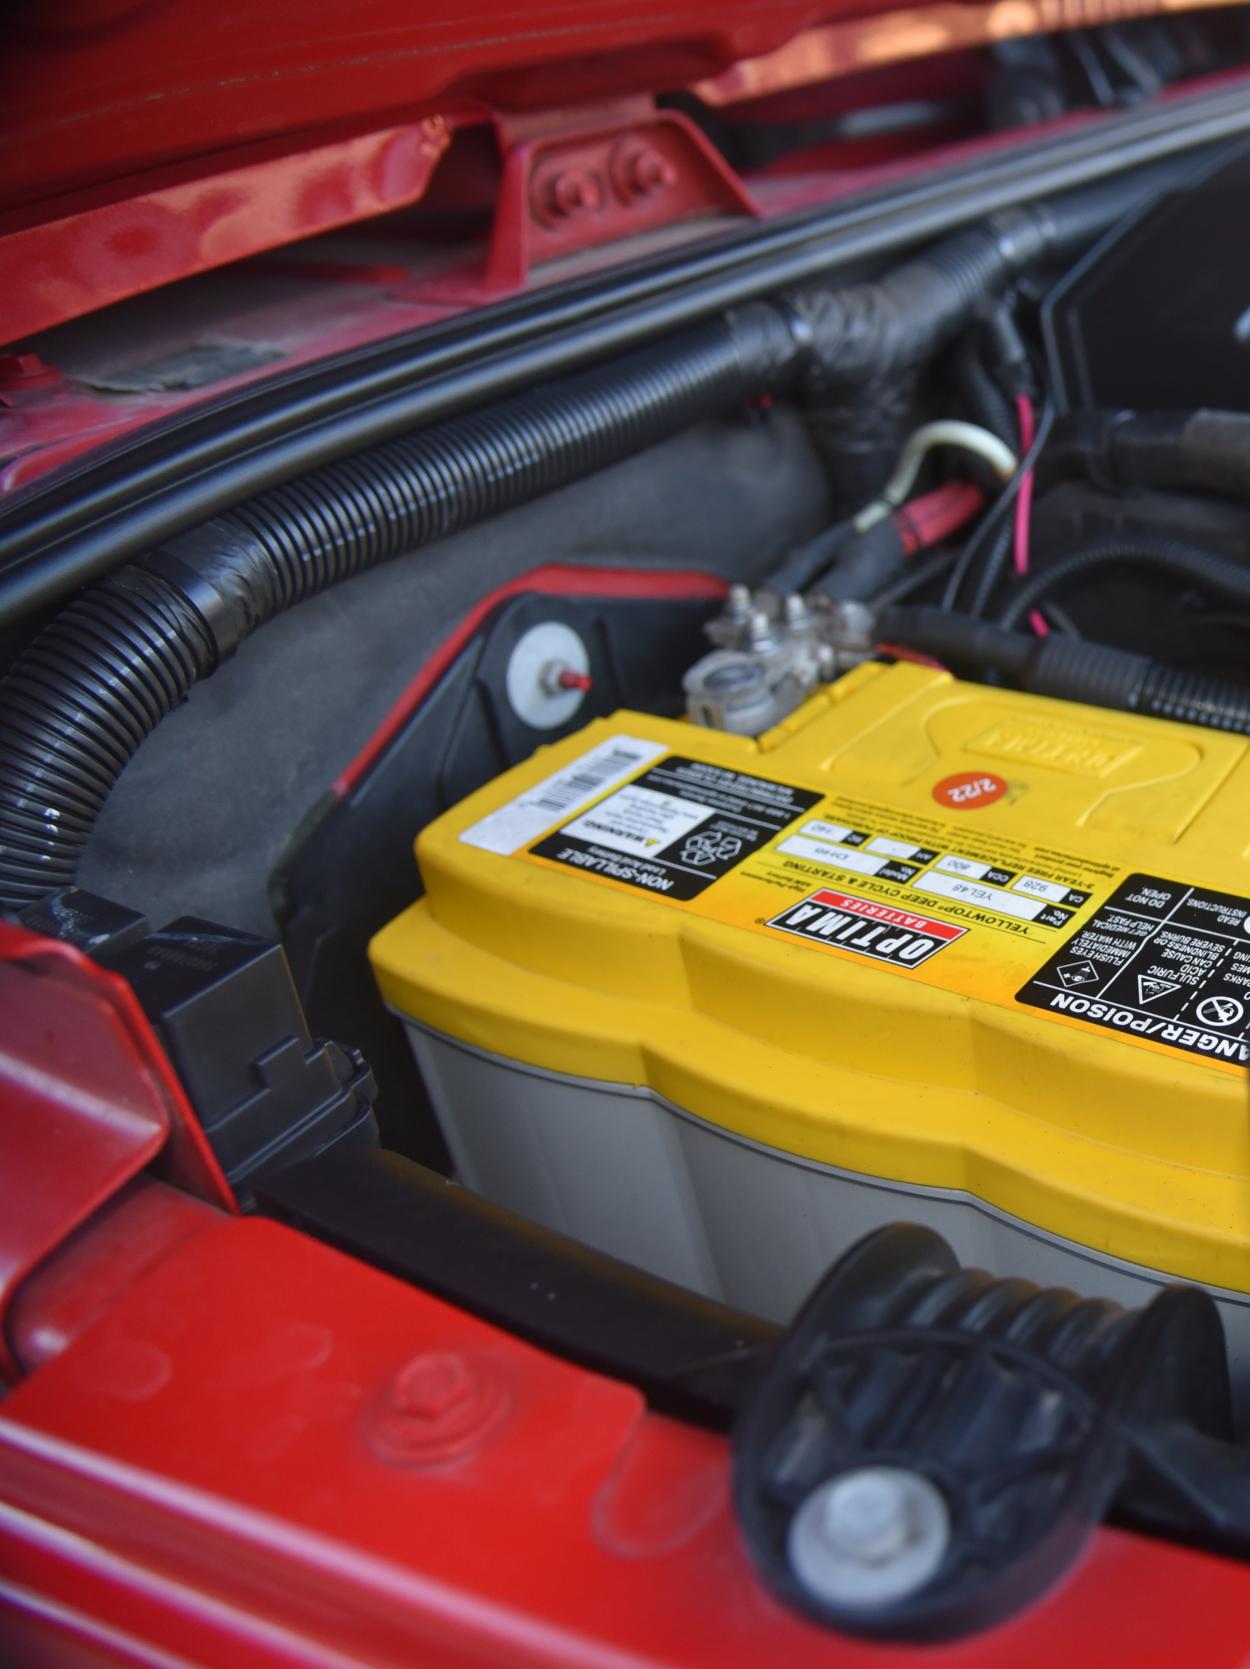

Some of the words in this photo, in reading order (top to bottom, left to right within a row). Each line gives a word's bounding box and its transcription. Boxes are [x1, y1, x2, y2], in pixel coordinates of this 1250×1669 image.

[947, 778, 997, 802] 2/22
[950, 847, 1025, 873] REPLACEMENT
[556, 848, 674, 891] NON-SPILLABLE
[783, 861, 846, 882] STARTING
[1026, 868, 1054, 879] FREE
[987, 871, 1009, 883] CCA
[1054, 875, 1096, 888] 3-YEAR
[859, 880, 901, 897] CYCLE
[952, 883, 993, 901] YEL48
[900, 894, 937, 908] DEEP
[1068, 894, 1084, 904] CA
[1125, 893, 1149, 904] NOT
[1148, 899, 1165, 908] DO
[840, 899, 927, 928] BATTERIES
[1040, 913, 1064, 926] Part
[1053, 909, 1069, 919] No.
[1109, 914, 1131, 925] FAST.
[1092, 919, 1129, 934] MEDICAL
[1130, 919, 1155, 931] HELP
[1217, 916, 1240, 926] READ
[785, 905, 935, 960] OPTIMA
[1082, 931, 1113, 944] WATER.
[1128, 927, 1148, 936] GET
[1071, 938, 1131, 958] IMMEDIATELY
[1112, 938, 1136, 950] WITH
[1153, 937, 1168, 946] OR
[1190, 938, 1225, 952] SEVERE
[1070, 946, 1094, 958] EYES
[1161, 949, 1193, 962] CAUSE
[1168, 940, 1219, 960] BLINDNESS
[1094, 954, 1124, 966] FLUSH
[1192, 957, 1213, 968] CAN
[1147, 965, 1200, 985] SULFURIC
[1180, 964, 1207, 976] ACID
